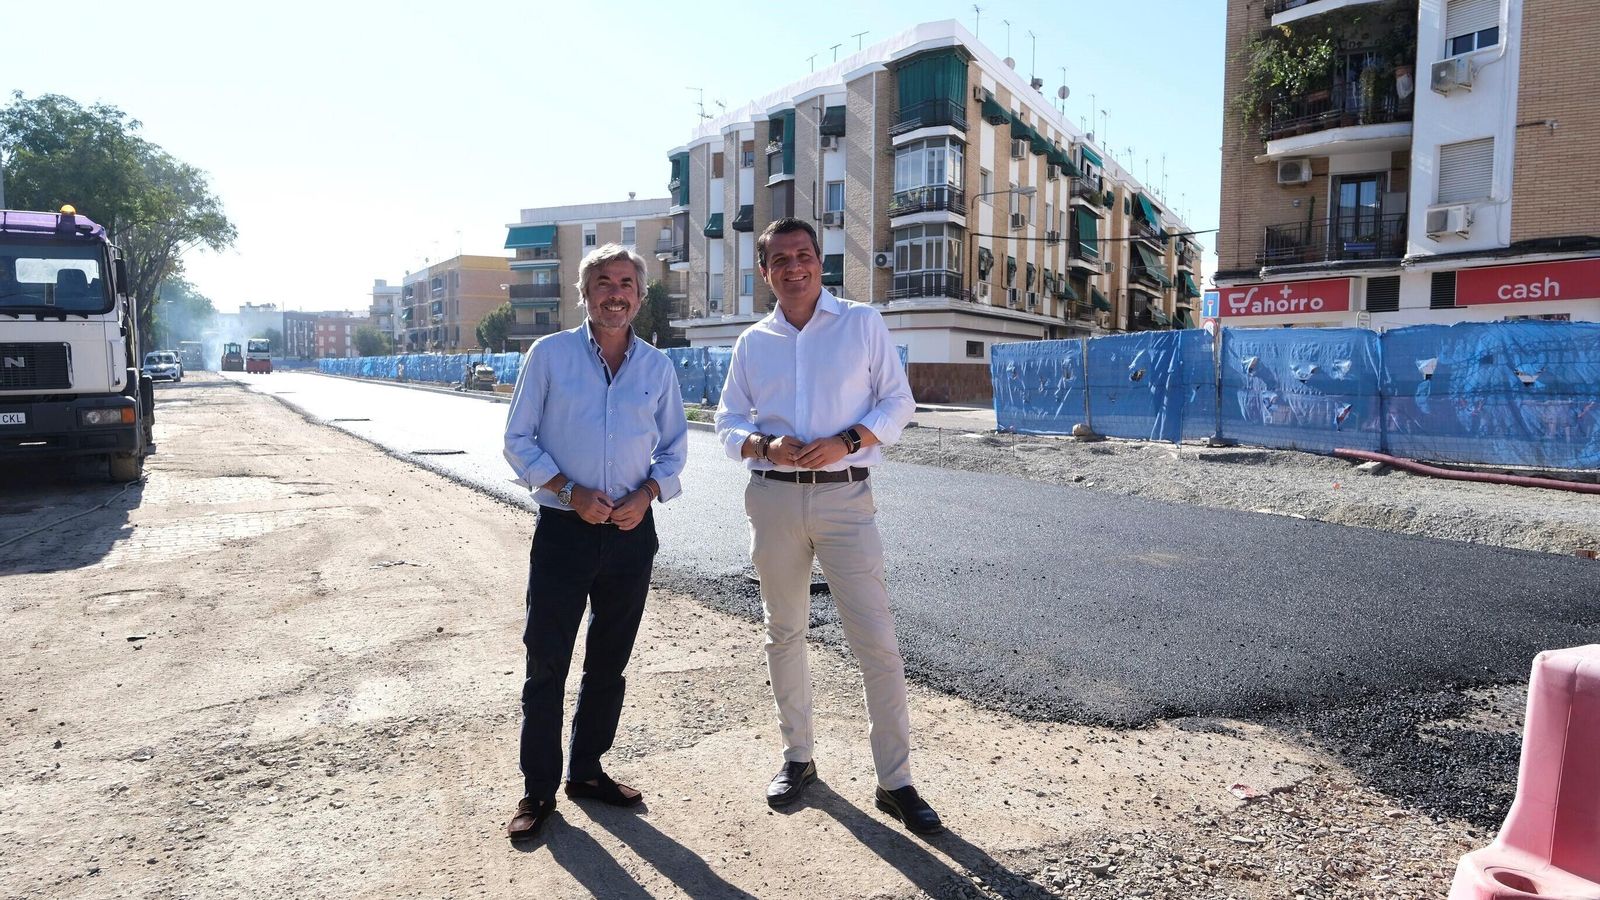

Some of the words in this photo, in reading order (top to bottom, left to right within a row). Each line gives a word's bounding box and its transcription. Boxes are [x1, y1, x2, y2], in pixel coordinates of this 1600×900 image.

[1497, 276, 1560, 300] cash
[1251, 296, 1324, 314] ahorro
[4, 356, 25, 368] N
[2, 413, 23, 424] CKL
